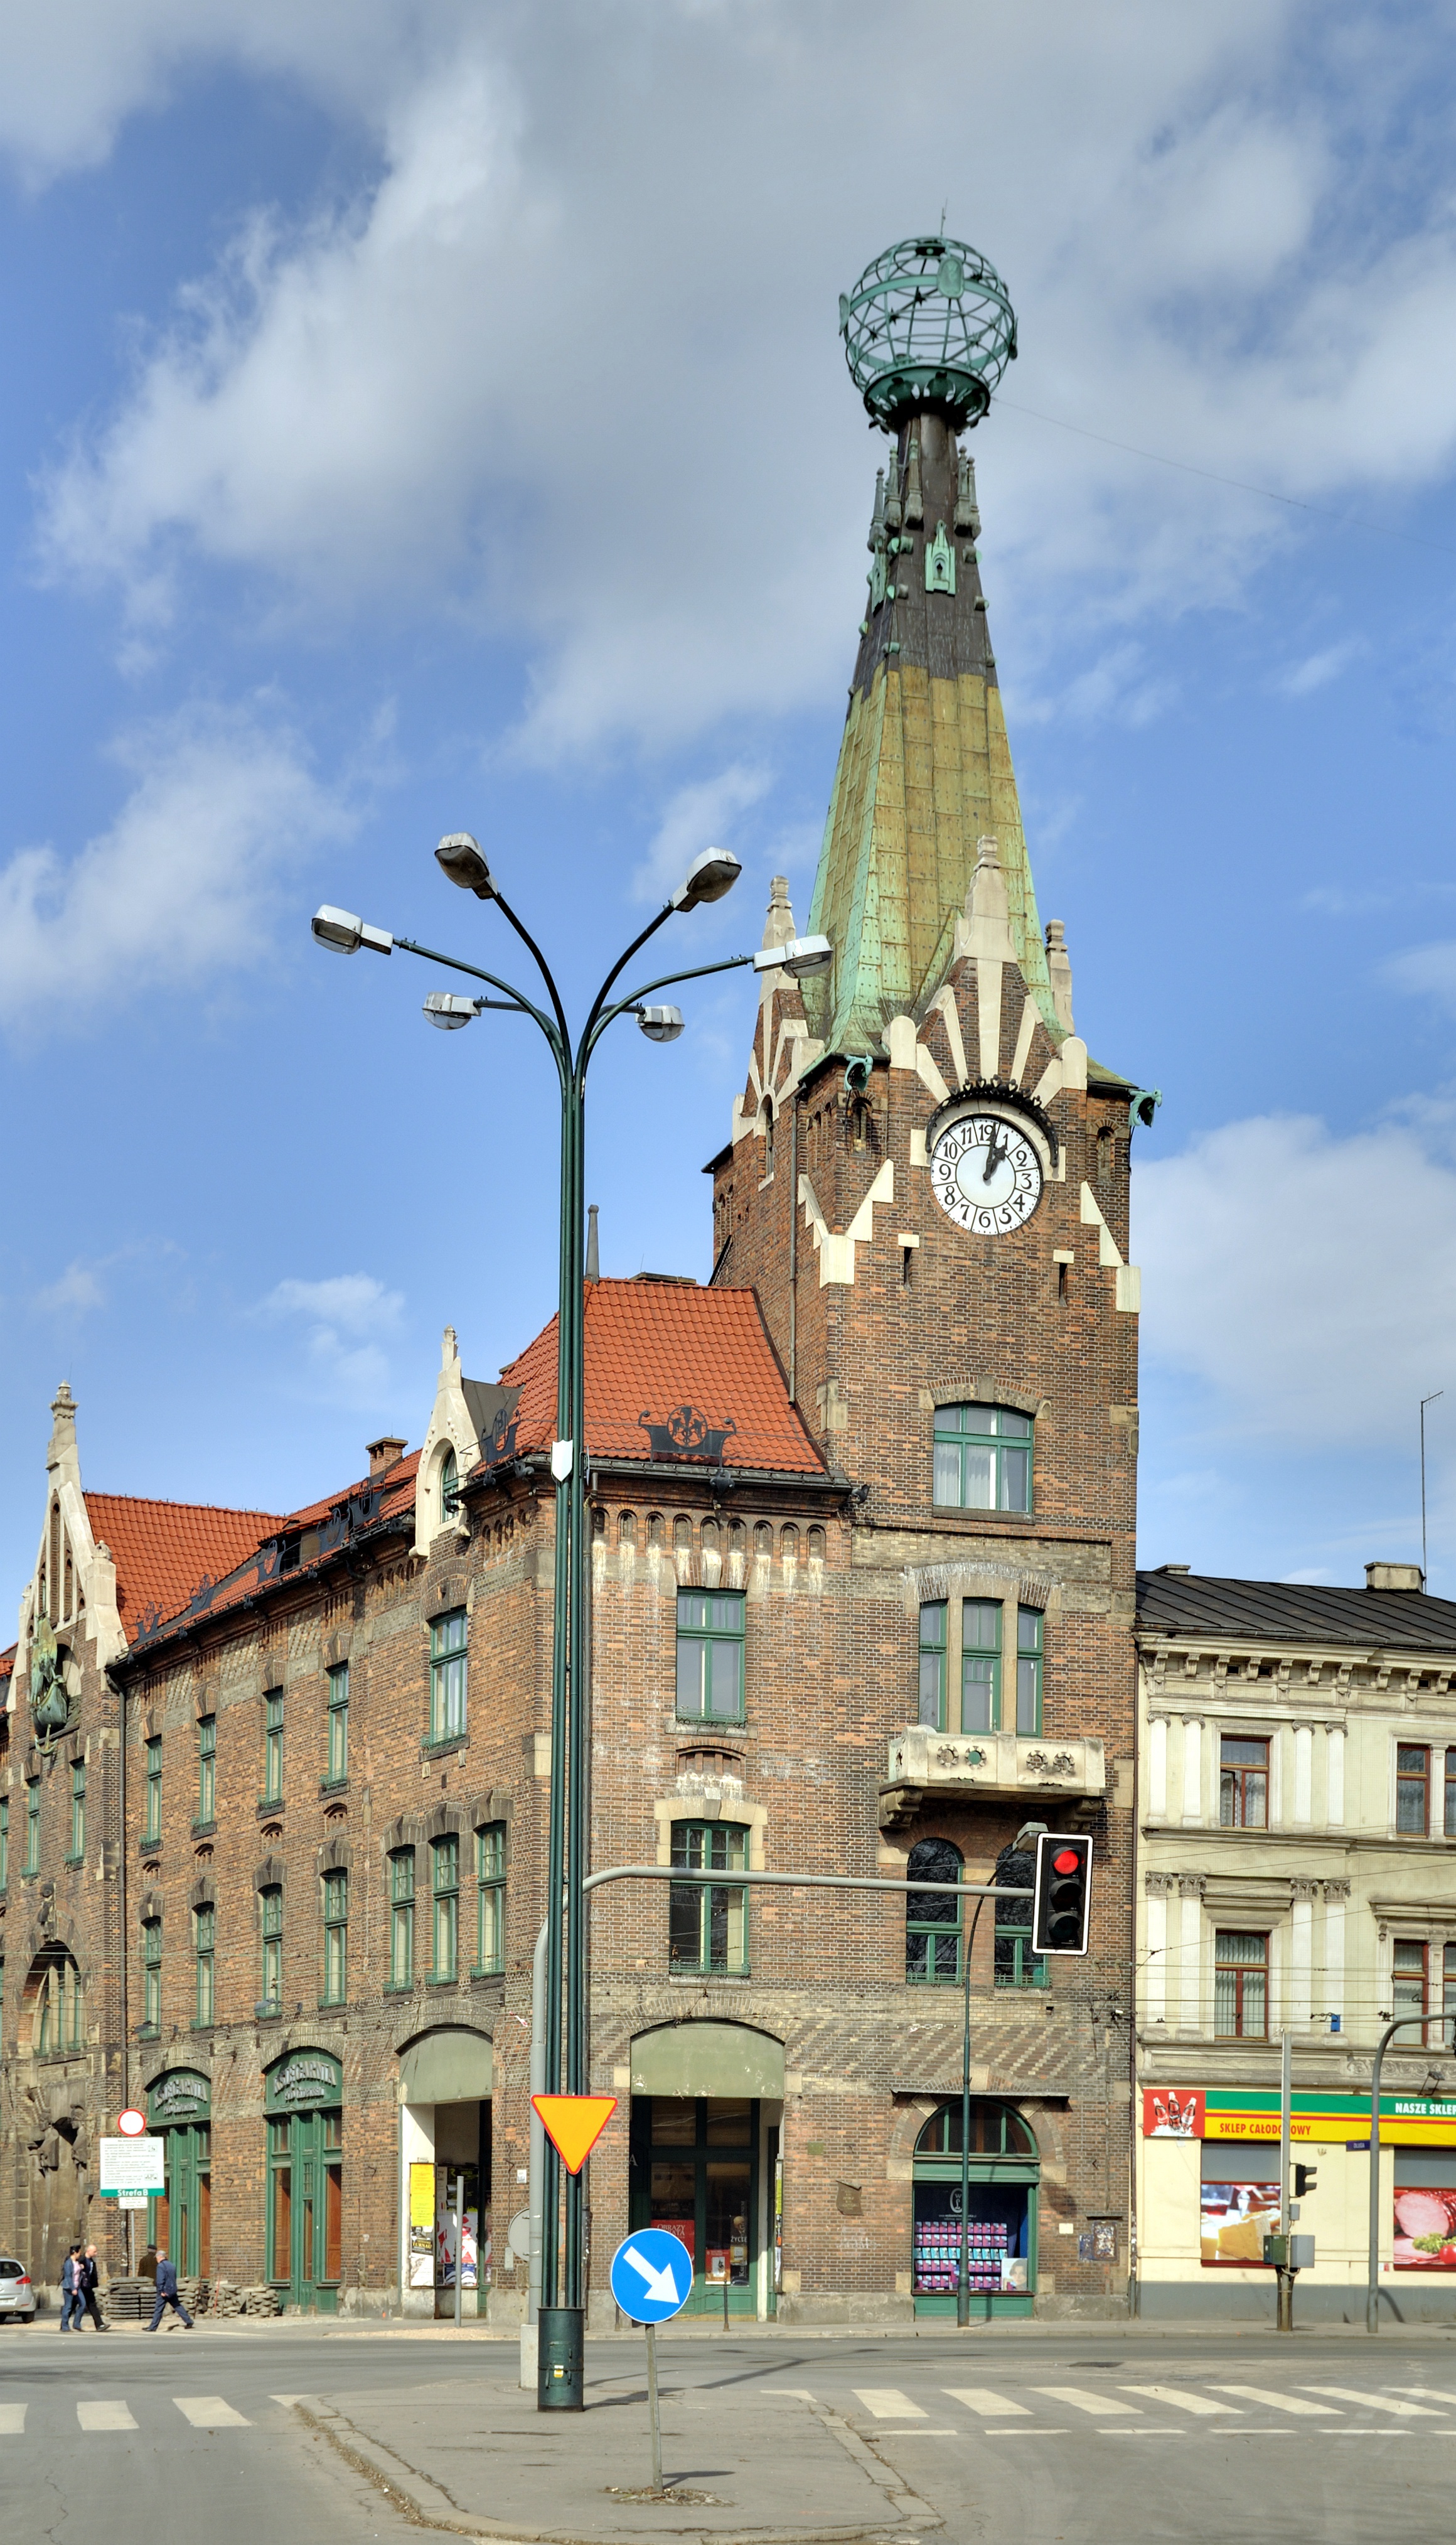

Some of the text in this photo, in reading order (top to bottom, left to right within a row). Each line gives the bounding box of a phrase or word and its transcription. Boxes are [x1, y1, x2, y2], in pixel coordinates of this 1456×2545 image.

[960, 1126, 972, 1145] 11
[1002, 1133, 1009, 1150] 1
[943, 1141, 958, 1160] 10
[1015, 1150, 1027, 1168] 2
[939, 1163, 951, 1180] 9
[1021, 1173, 1032, 1190] 3
[944, 1185, 955, 1205] 8
[1013, 1193, 1025, 1212] 4
[960, 1204, 970, 1222] 7
[978, 1210, 991, 1228] 6
[999, 1207, 1012, 1225] 5
[1395, 2102, 1427, 2114] NASZE
[1220, 2123, 1246, 2134] SKLEP
